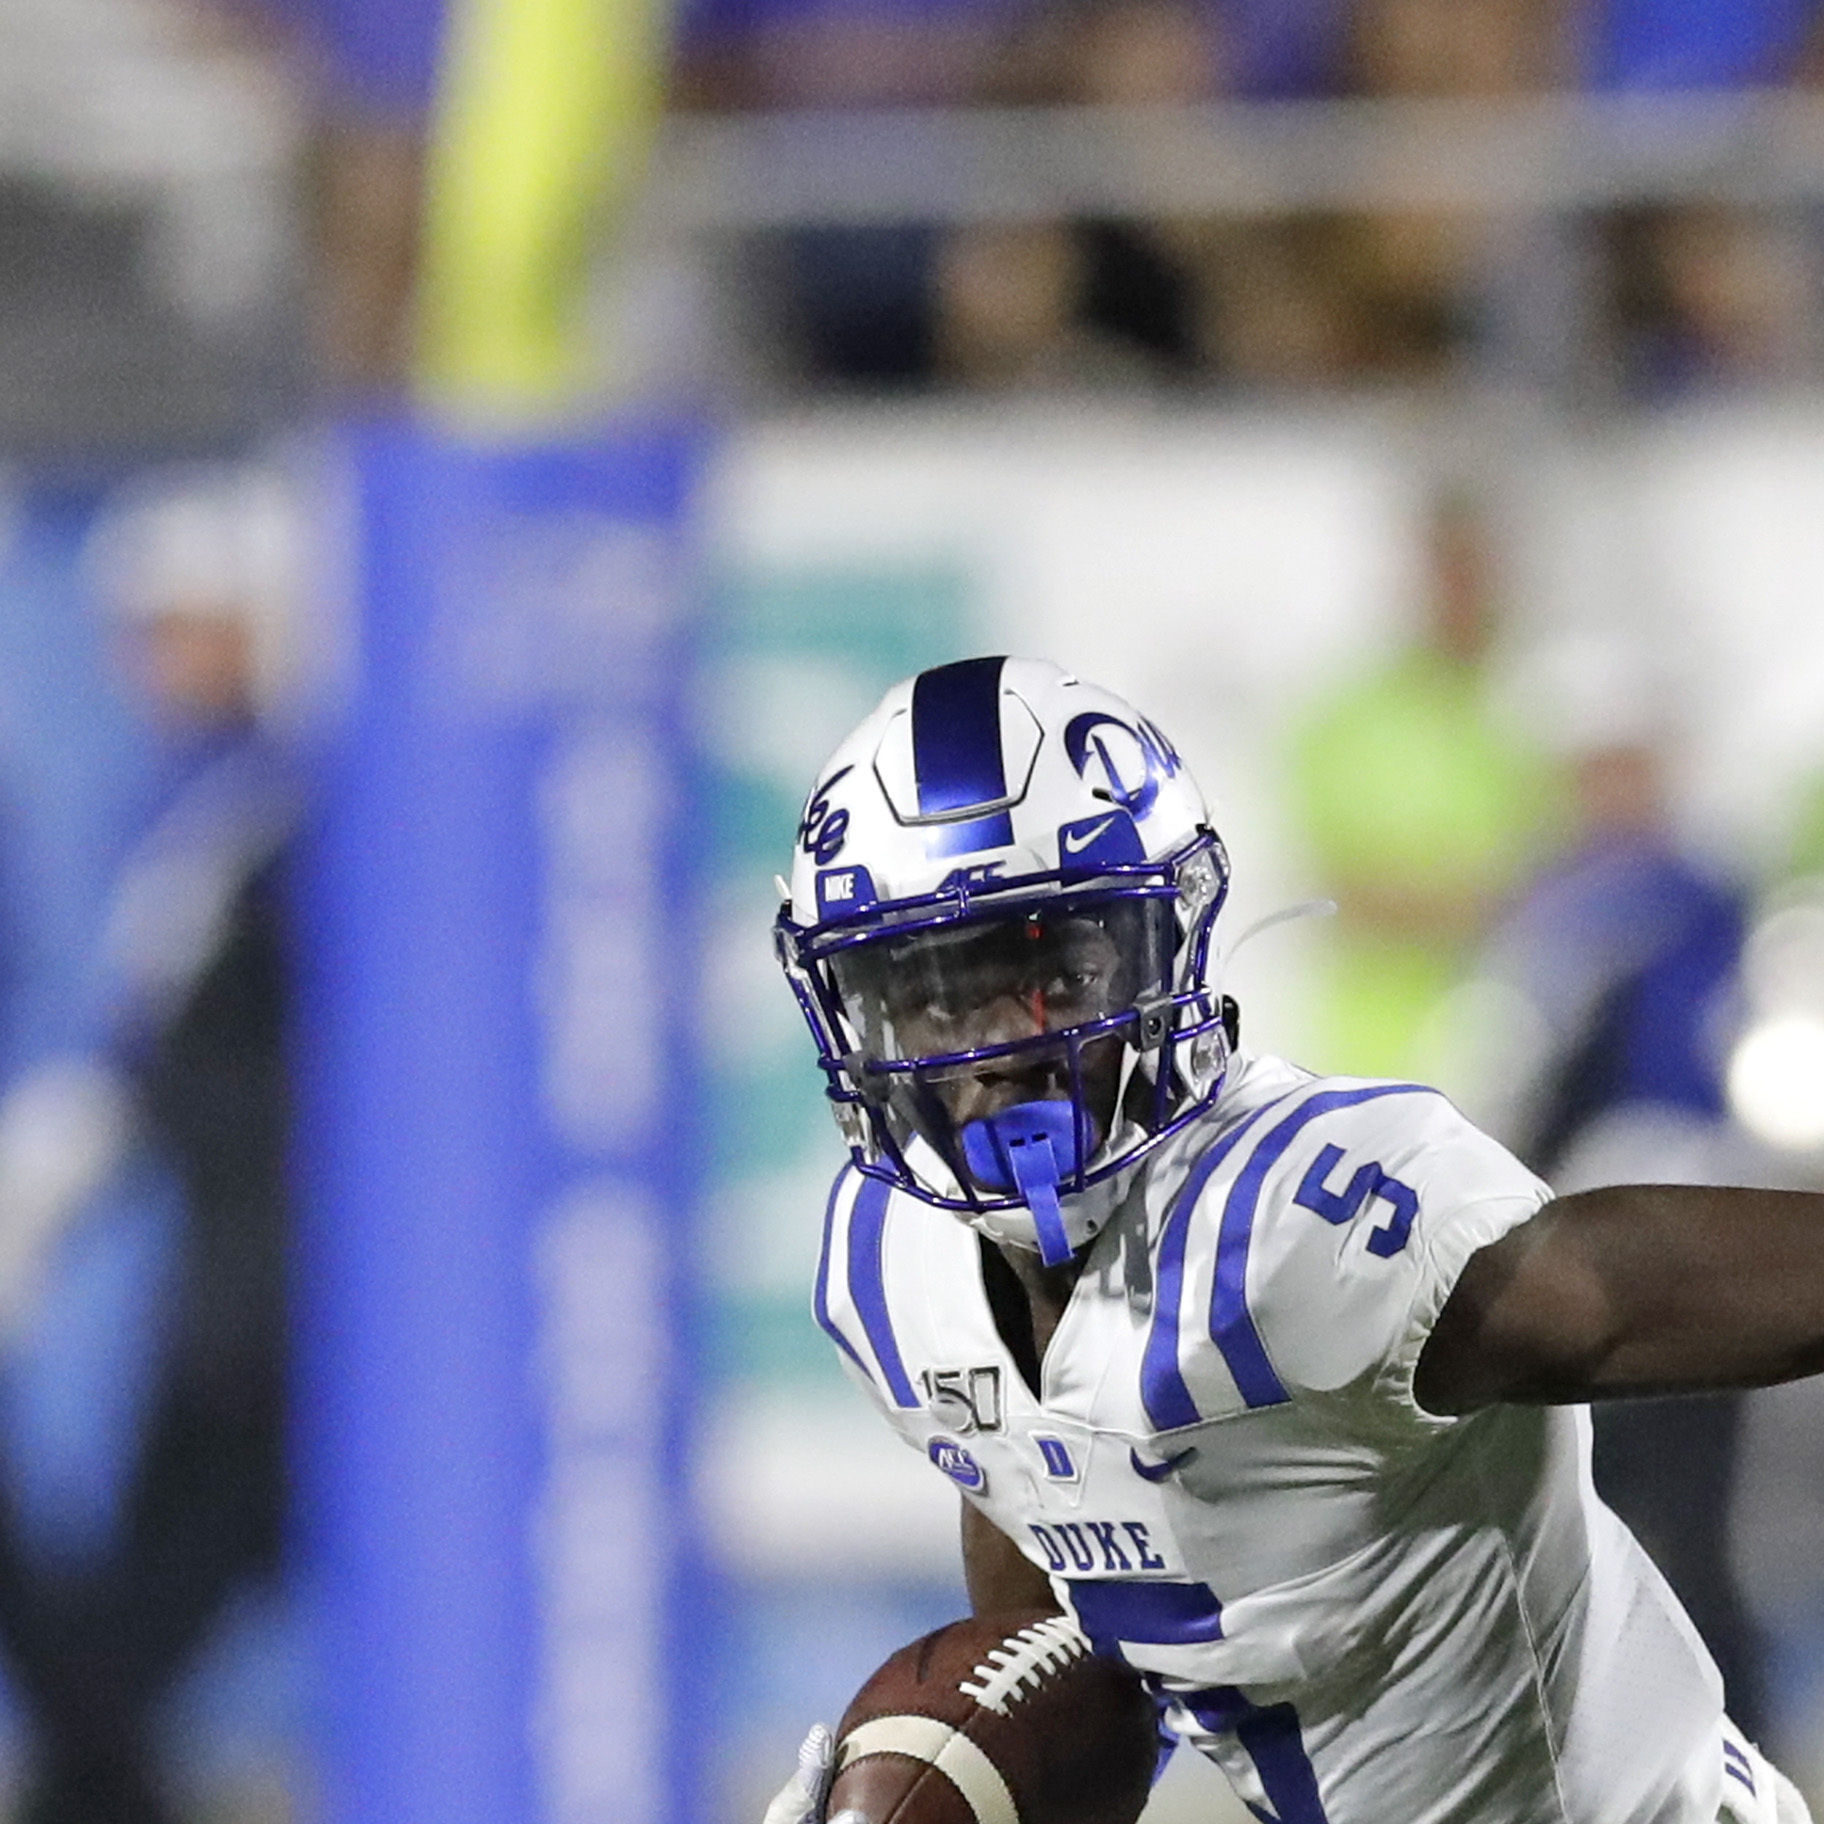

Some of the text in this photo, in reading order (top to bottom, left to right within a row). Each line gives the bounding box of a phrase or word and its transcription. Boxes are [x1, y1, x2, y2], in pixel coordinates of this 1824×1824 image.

[824, 872, 856, 902] NIKE
[1293, 1142, 1419, 1258] 5
[920, 1364, 1001, 1433] 150
[1026, 1521, 1167, 1571] DUKE
